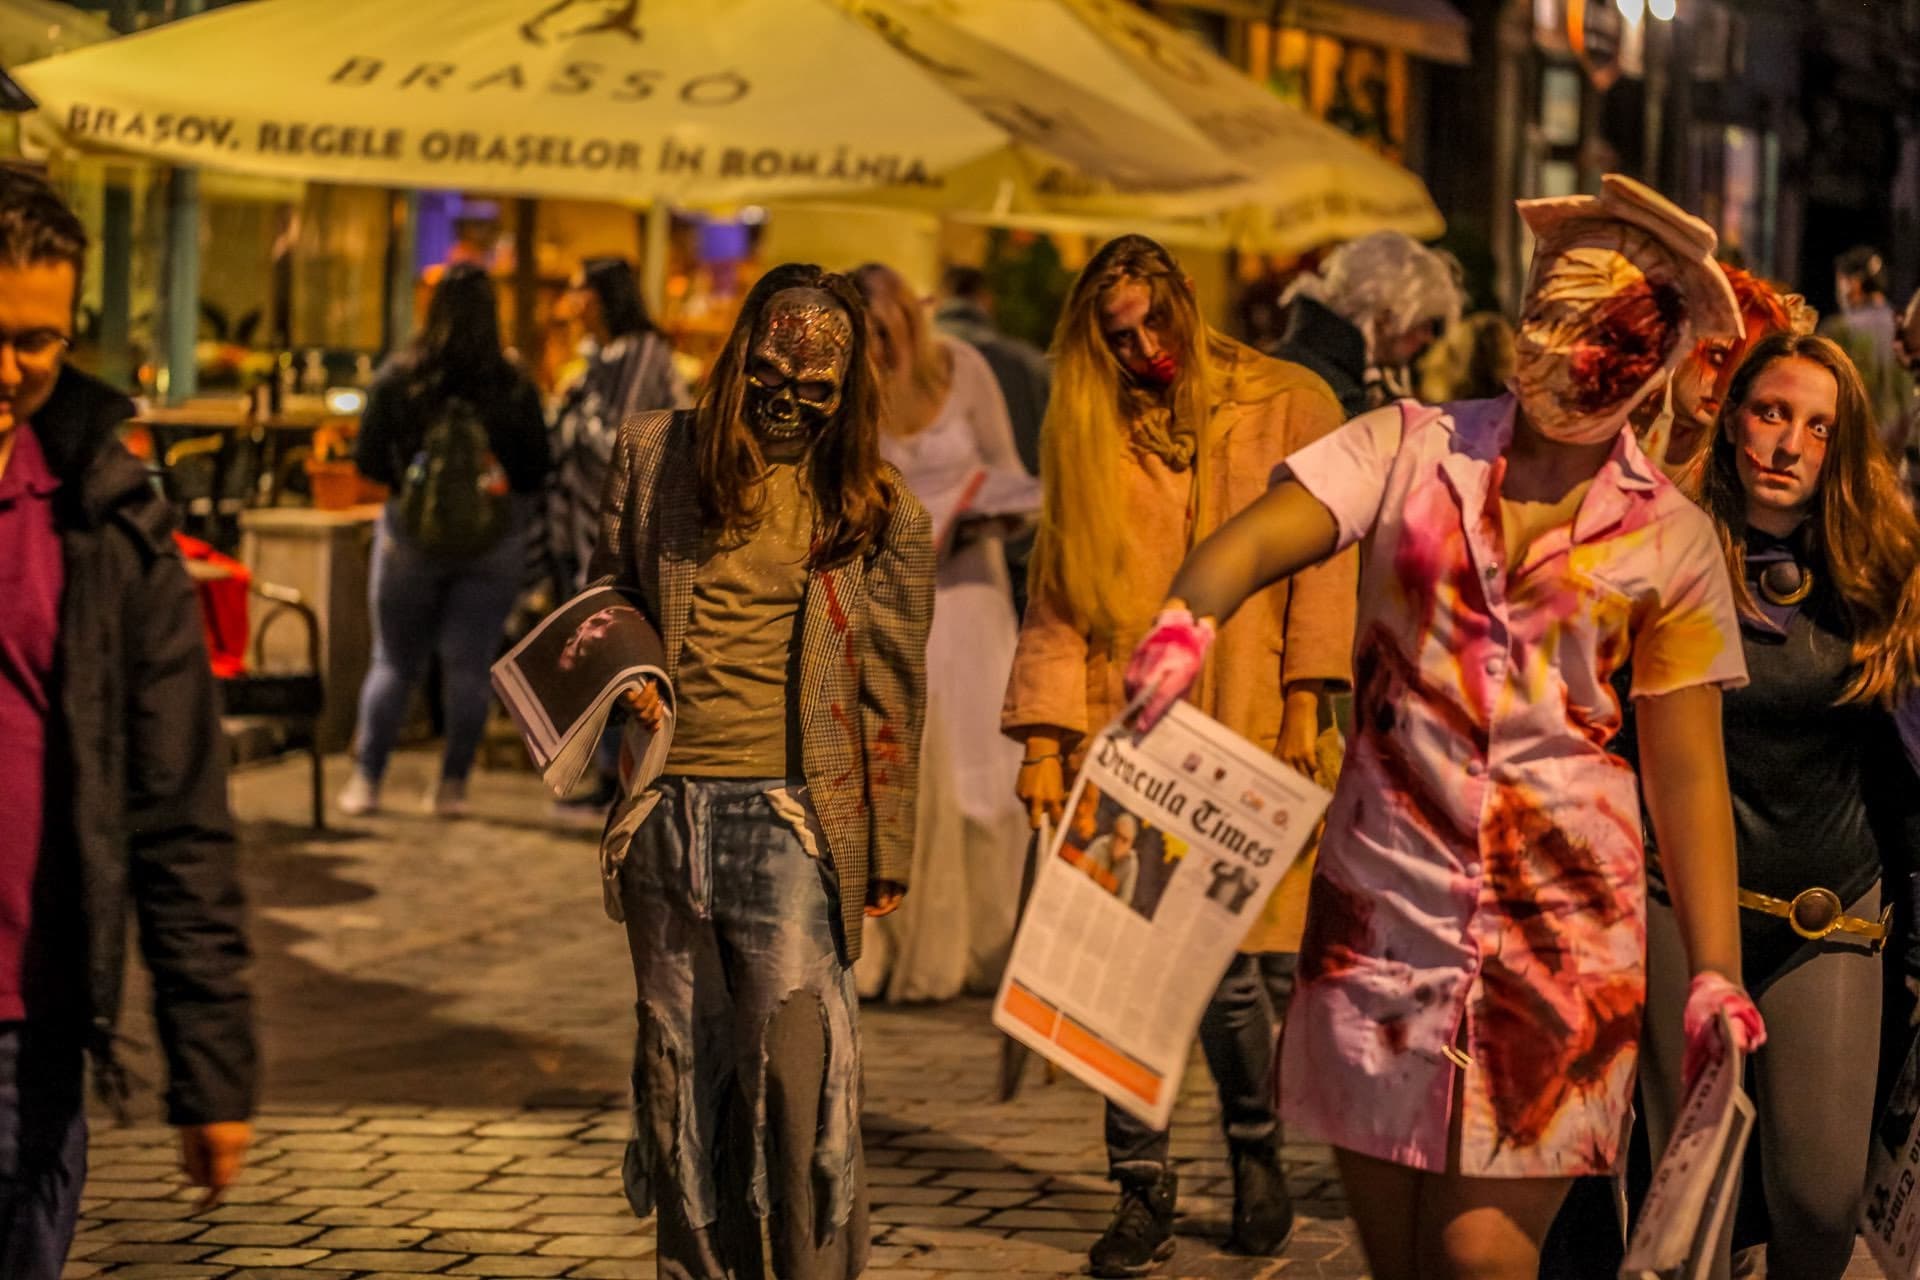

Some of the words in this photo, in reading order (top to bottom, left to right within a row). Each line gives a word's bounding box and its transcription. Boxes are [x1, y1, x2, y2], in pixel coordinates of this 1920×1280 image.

[258, 121, 404, 160] REGELE
[1097, 735, 1187, 816] Dracula
[1190, 799, 1275, 867] Times
